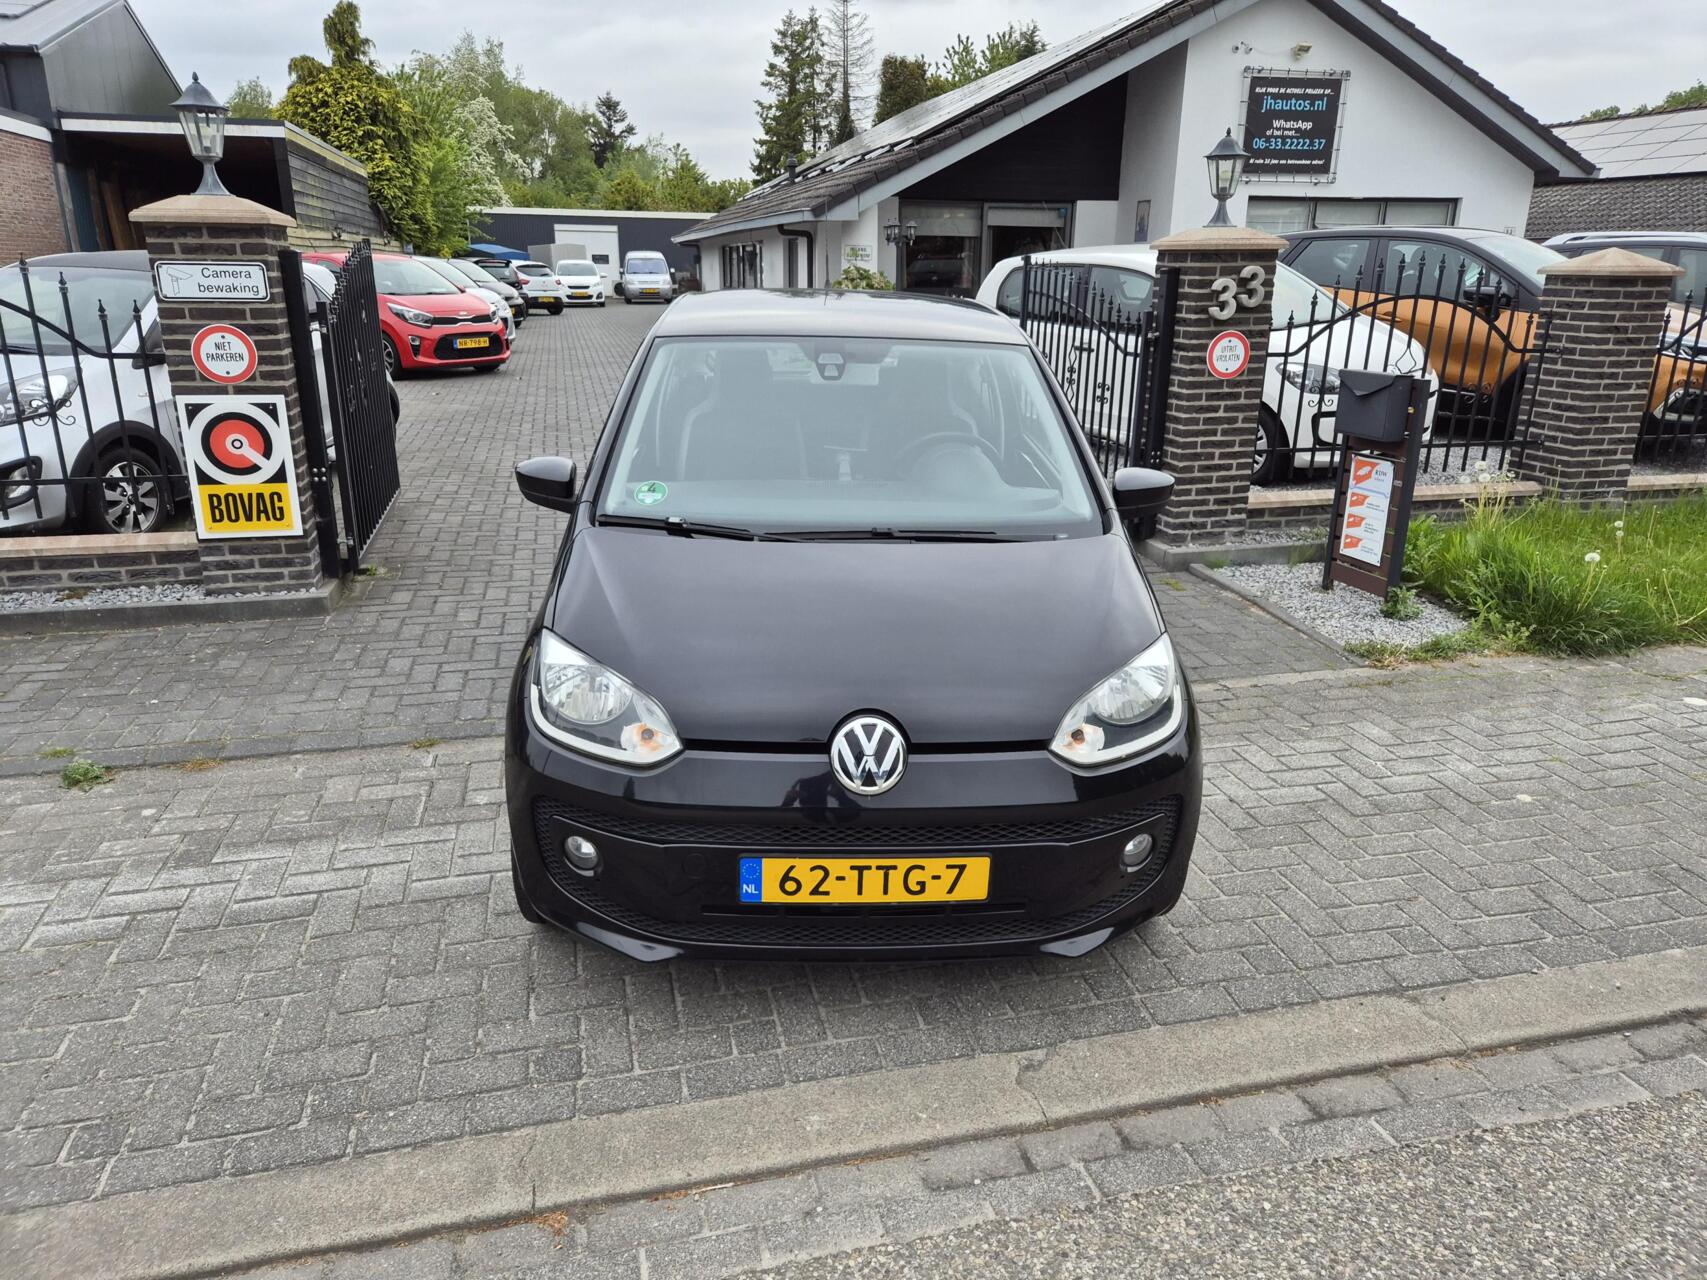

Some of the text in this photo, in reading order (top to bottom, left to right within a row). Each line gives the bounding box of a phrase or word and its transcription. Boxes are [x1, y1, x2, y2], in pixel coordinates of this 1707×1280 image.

[1261, 96, 1327, 112] jhautos.nl
[1272, 120, 1313, 131] WhatsApp
[1252, 138, 1326, 150] 06-33.2222.37
[201, 267, 252, 279] Camera
[198, 283, 260, 296] bewaking
[1208, 265, 1265, 320] 33
[214, 342, 231, 352] NIET
[1221, 345, 1238, 353] UITRIT
[206, 353, 244, 363] PARKEREN
[207, 491, 285, 524] BOVAG
[778, 864, 968, 897] 62-TTG-7
[742, 884, 759, 894] NL
